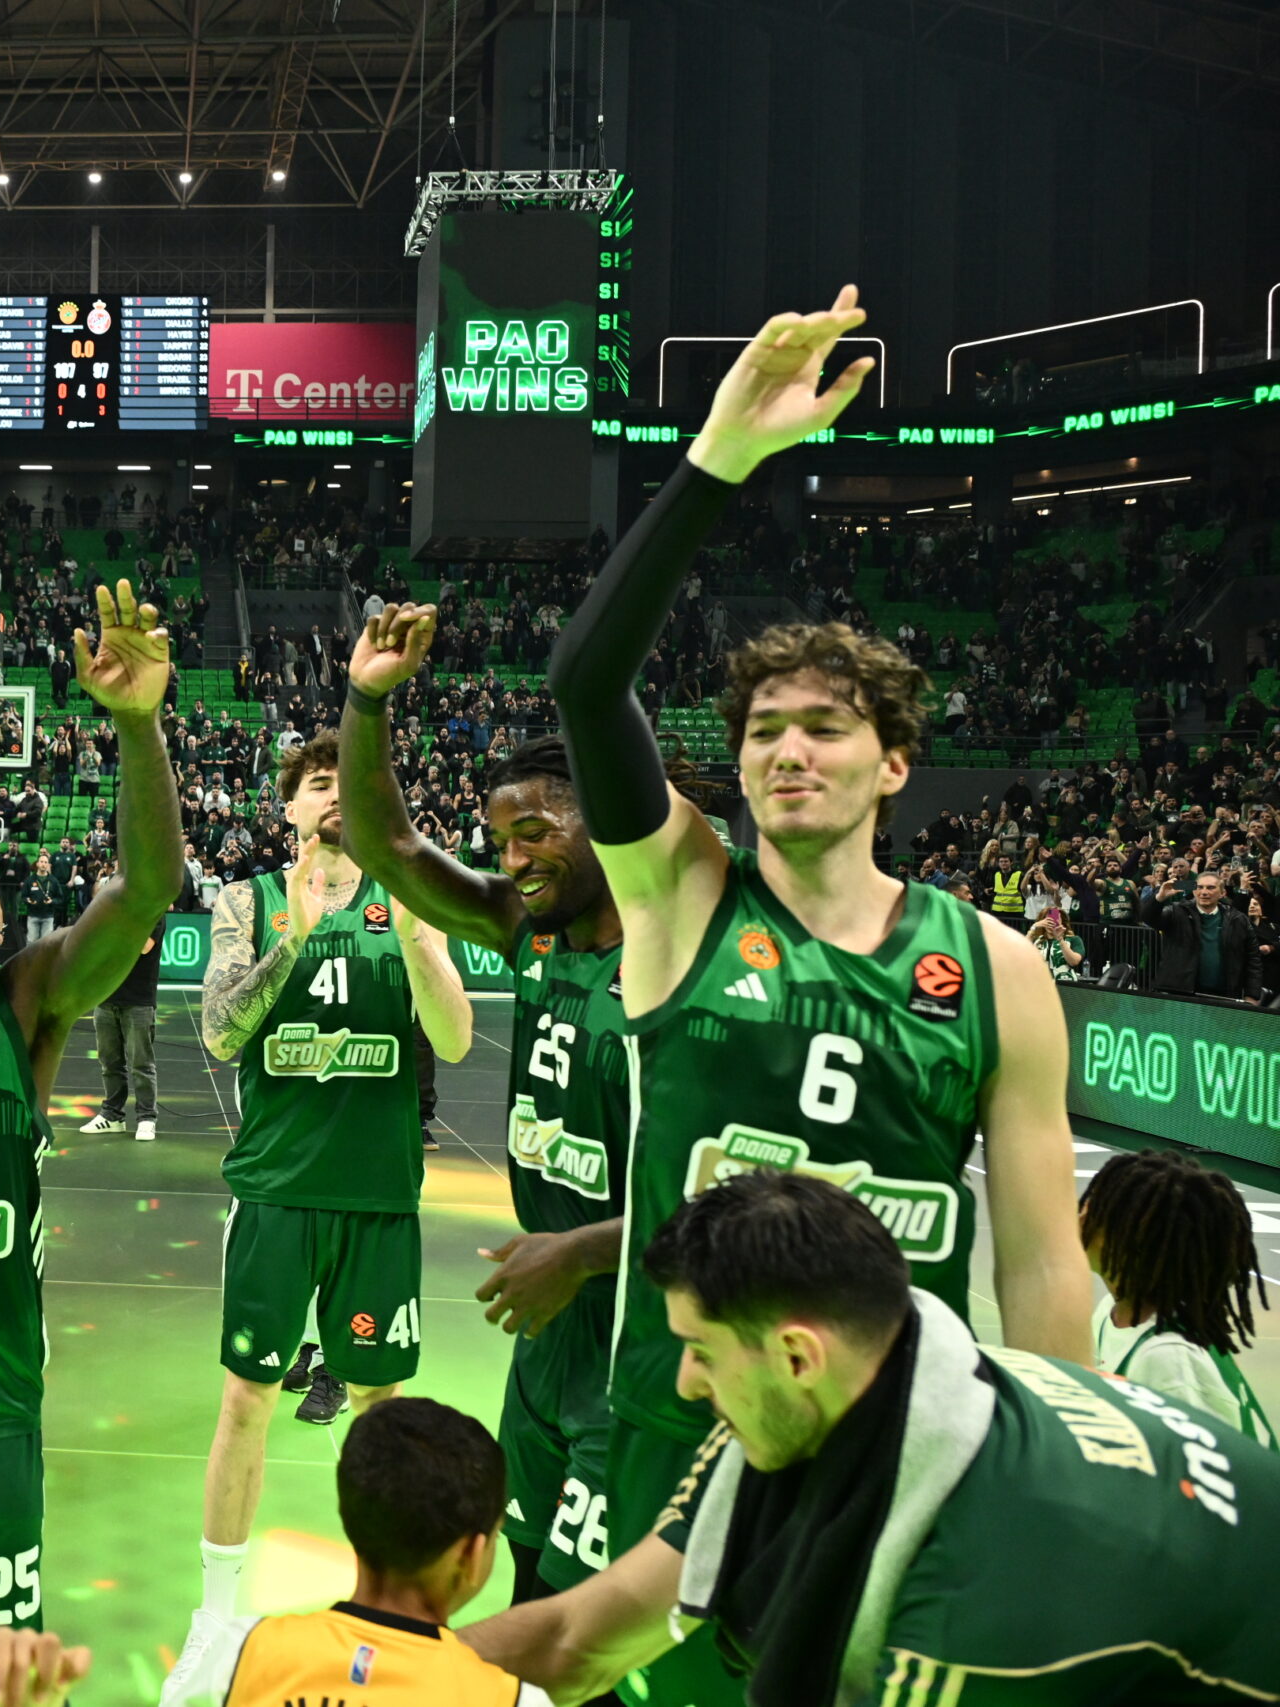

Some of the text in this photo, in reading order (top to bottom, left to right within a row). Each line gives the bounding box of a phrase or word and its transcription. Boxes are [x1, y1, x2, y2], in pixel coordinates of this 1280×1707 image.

[71, 340, 94, 358] 0.0
[466, 320, 569, 364] PAO
[58, 383, 106, 399] 0 4 0
[226, 369, 414, 412] T Center
[442, 367, 588, 411] WINS
[1254, 385, 1280, 404] PA
[57, 405, 106, 416] 1 3
[1064, 402, 1175, 432] PAO WINS!
[264, 430, 353, 445] PAO WINS!
[625, 427, 678, 442] WINS!
[899, 428, 994, 444] PAO WINS!
[308, 957, 349, 1004] 41
[282, 1028, 312, 1041] pame
[1084, 1022, 1177, 1103] PAO
[799, 1032, 863, 1124] 6
[729, 1136, 793, 1165] pame
[385, 1297, 420, 1348] 41
[550, 1477, 609, 1571] 26
